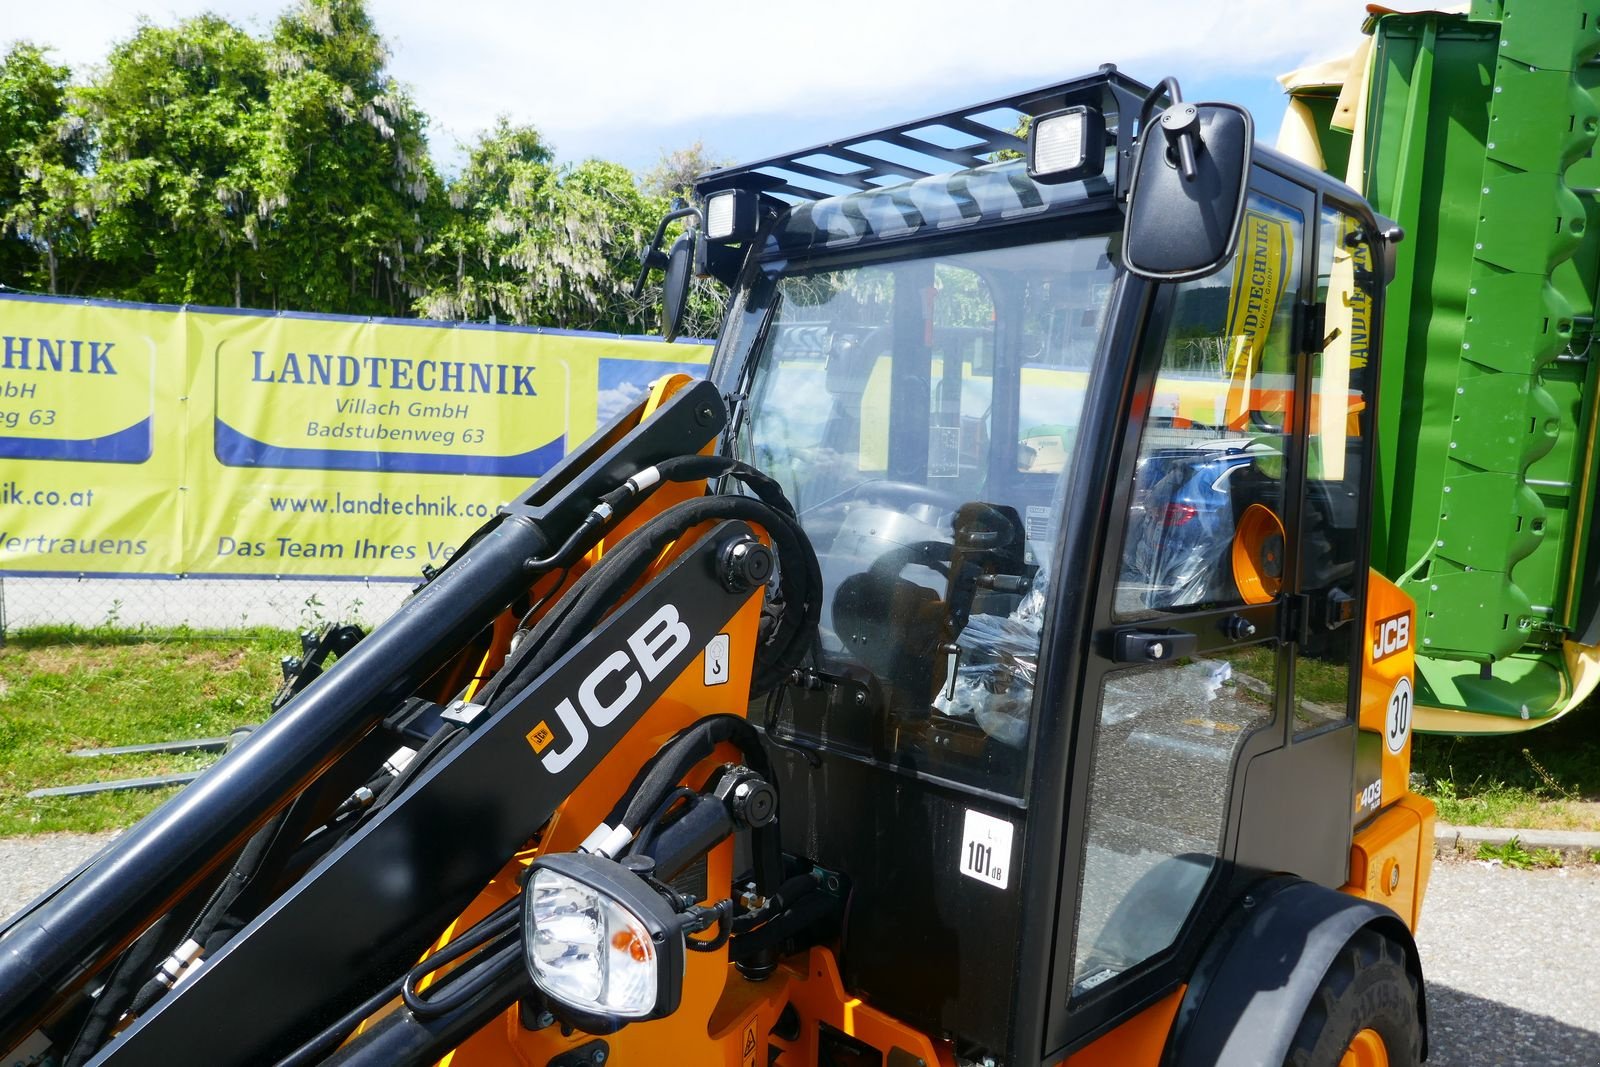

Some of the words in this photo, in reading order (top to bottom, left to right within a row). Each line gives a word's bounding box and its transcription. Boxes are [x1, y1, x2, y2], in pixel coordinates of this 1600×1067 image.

[252, 351, 537, 396] LANDTECHNIK
[0, 381, 36, 398] bH
[29, 409, 56, 425] 63
[336, 399, 401, 419] Villach
[408, 402, 469, 419] GmbH
[306, 422, 456, 446] Badstubenweg
[462, 428, 485, 444] 63
[217, 536, 266, 557] Das
[277, 537, 344, 559] Team
[354, 539, 416, 560] Ihres
[1374, 615, 1409, 659] JCB
[541, 603, 691, 774] JCB
[1391, 691, 1408, 739] 30
[1360, 779, 1381, 807] 403
[968, 840, 992, 876] 101
[992, 866, 1002, 880] dB
